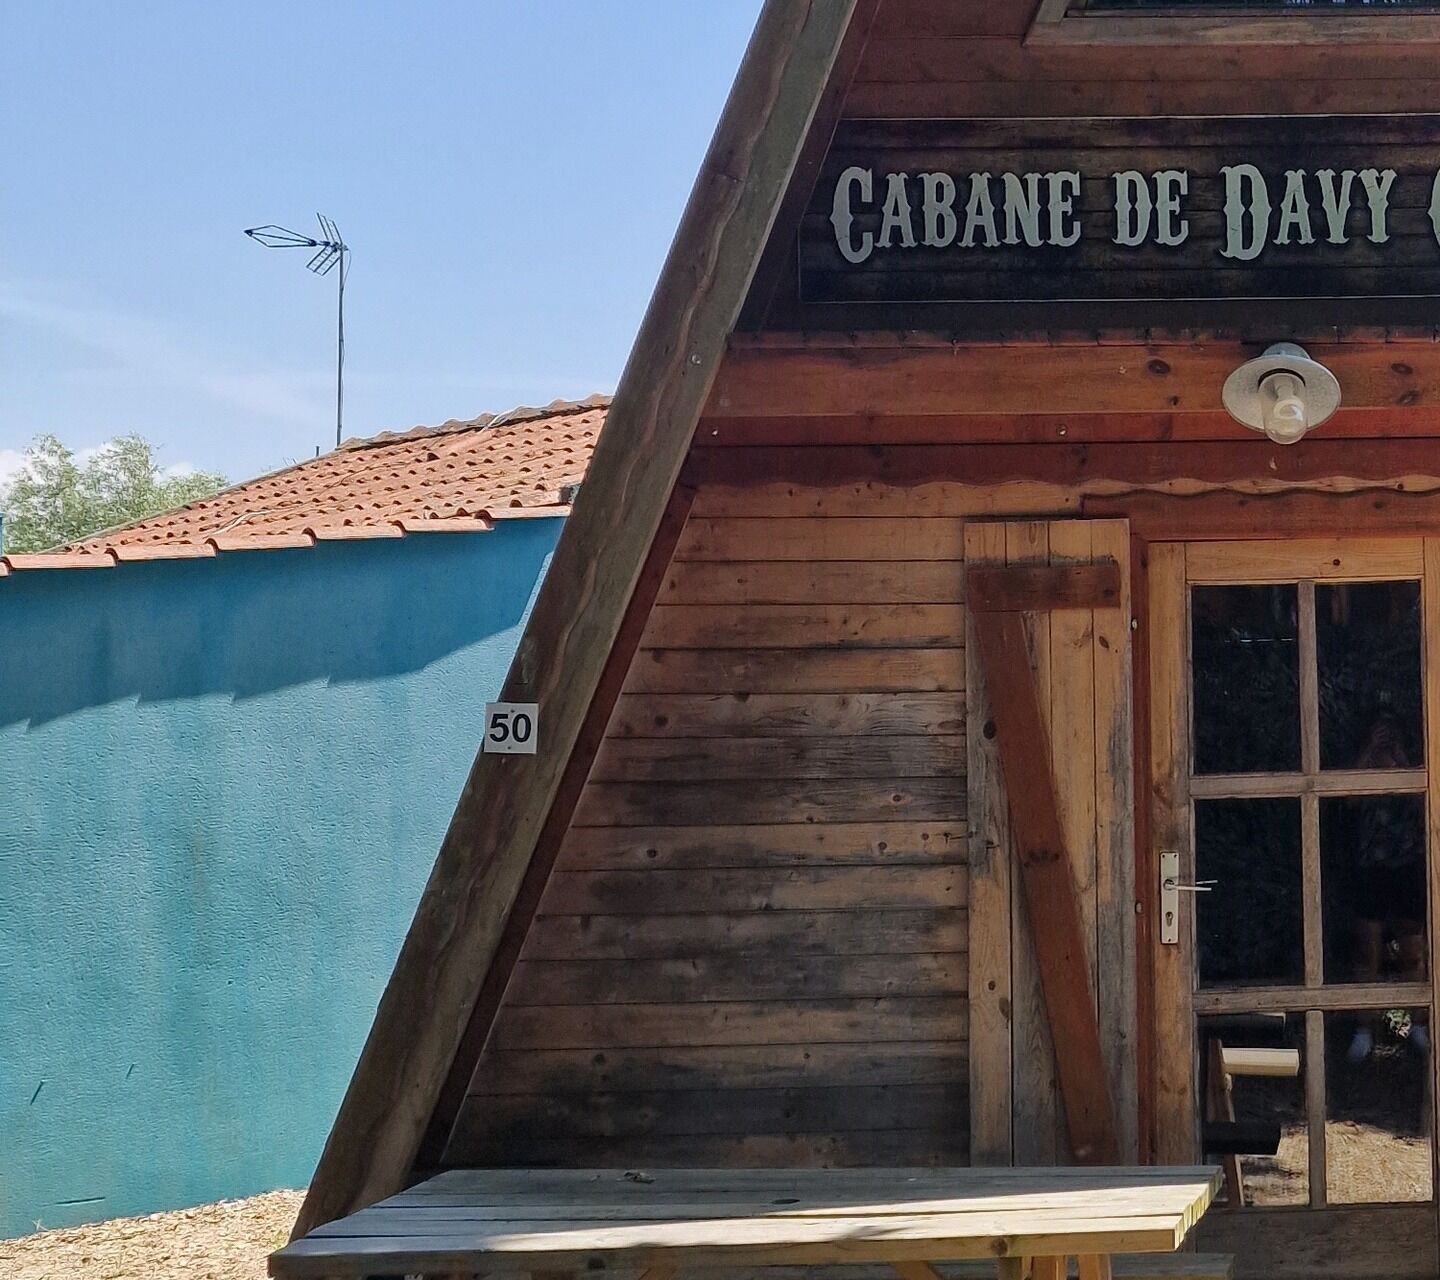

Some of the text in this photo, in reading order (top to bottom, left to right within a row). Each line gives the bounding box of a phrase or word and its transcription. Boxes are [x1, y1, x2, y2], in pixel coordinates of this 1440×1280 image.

[830, 166, 1082, 264] CABANE
[1111, 170, 1189, 247] DE
[1219, 163, 1397, 261] DAVY
[489, 713, 532, 743] 50
